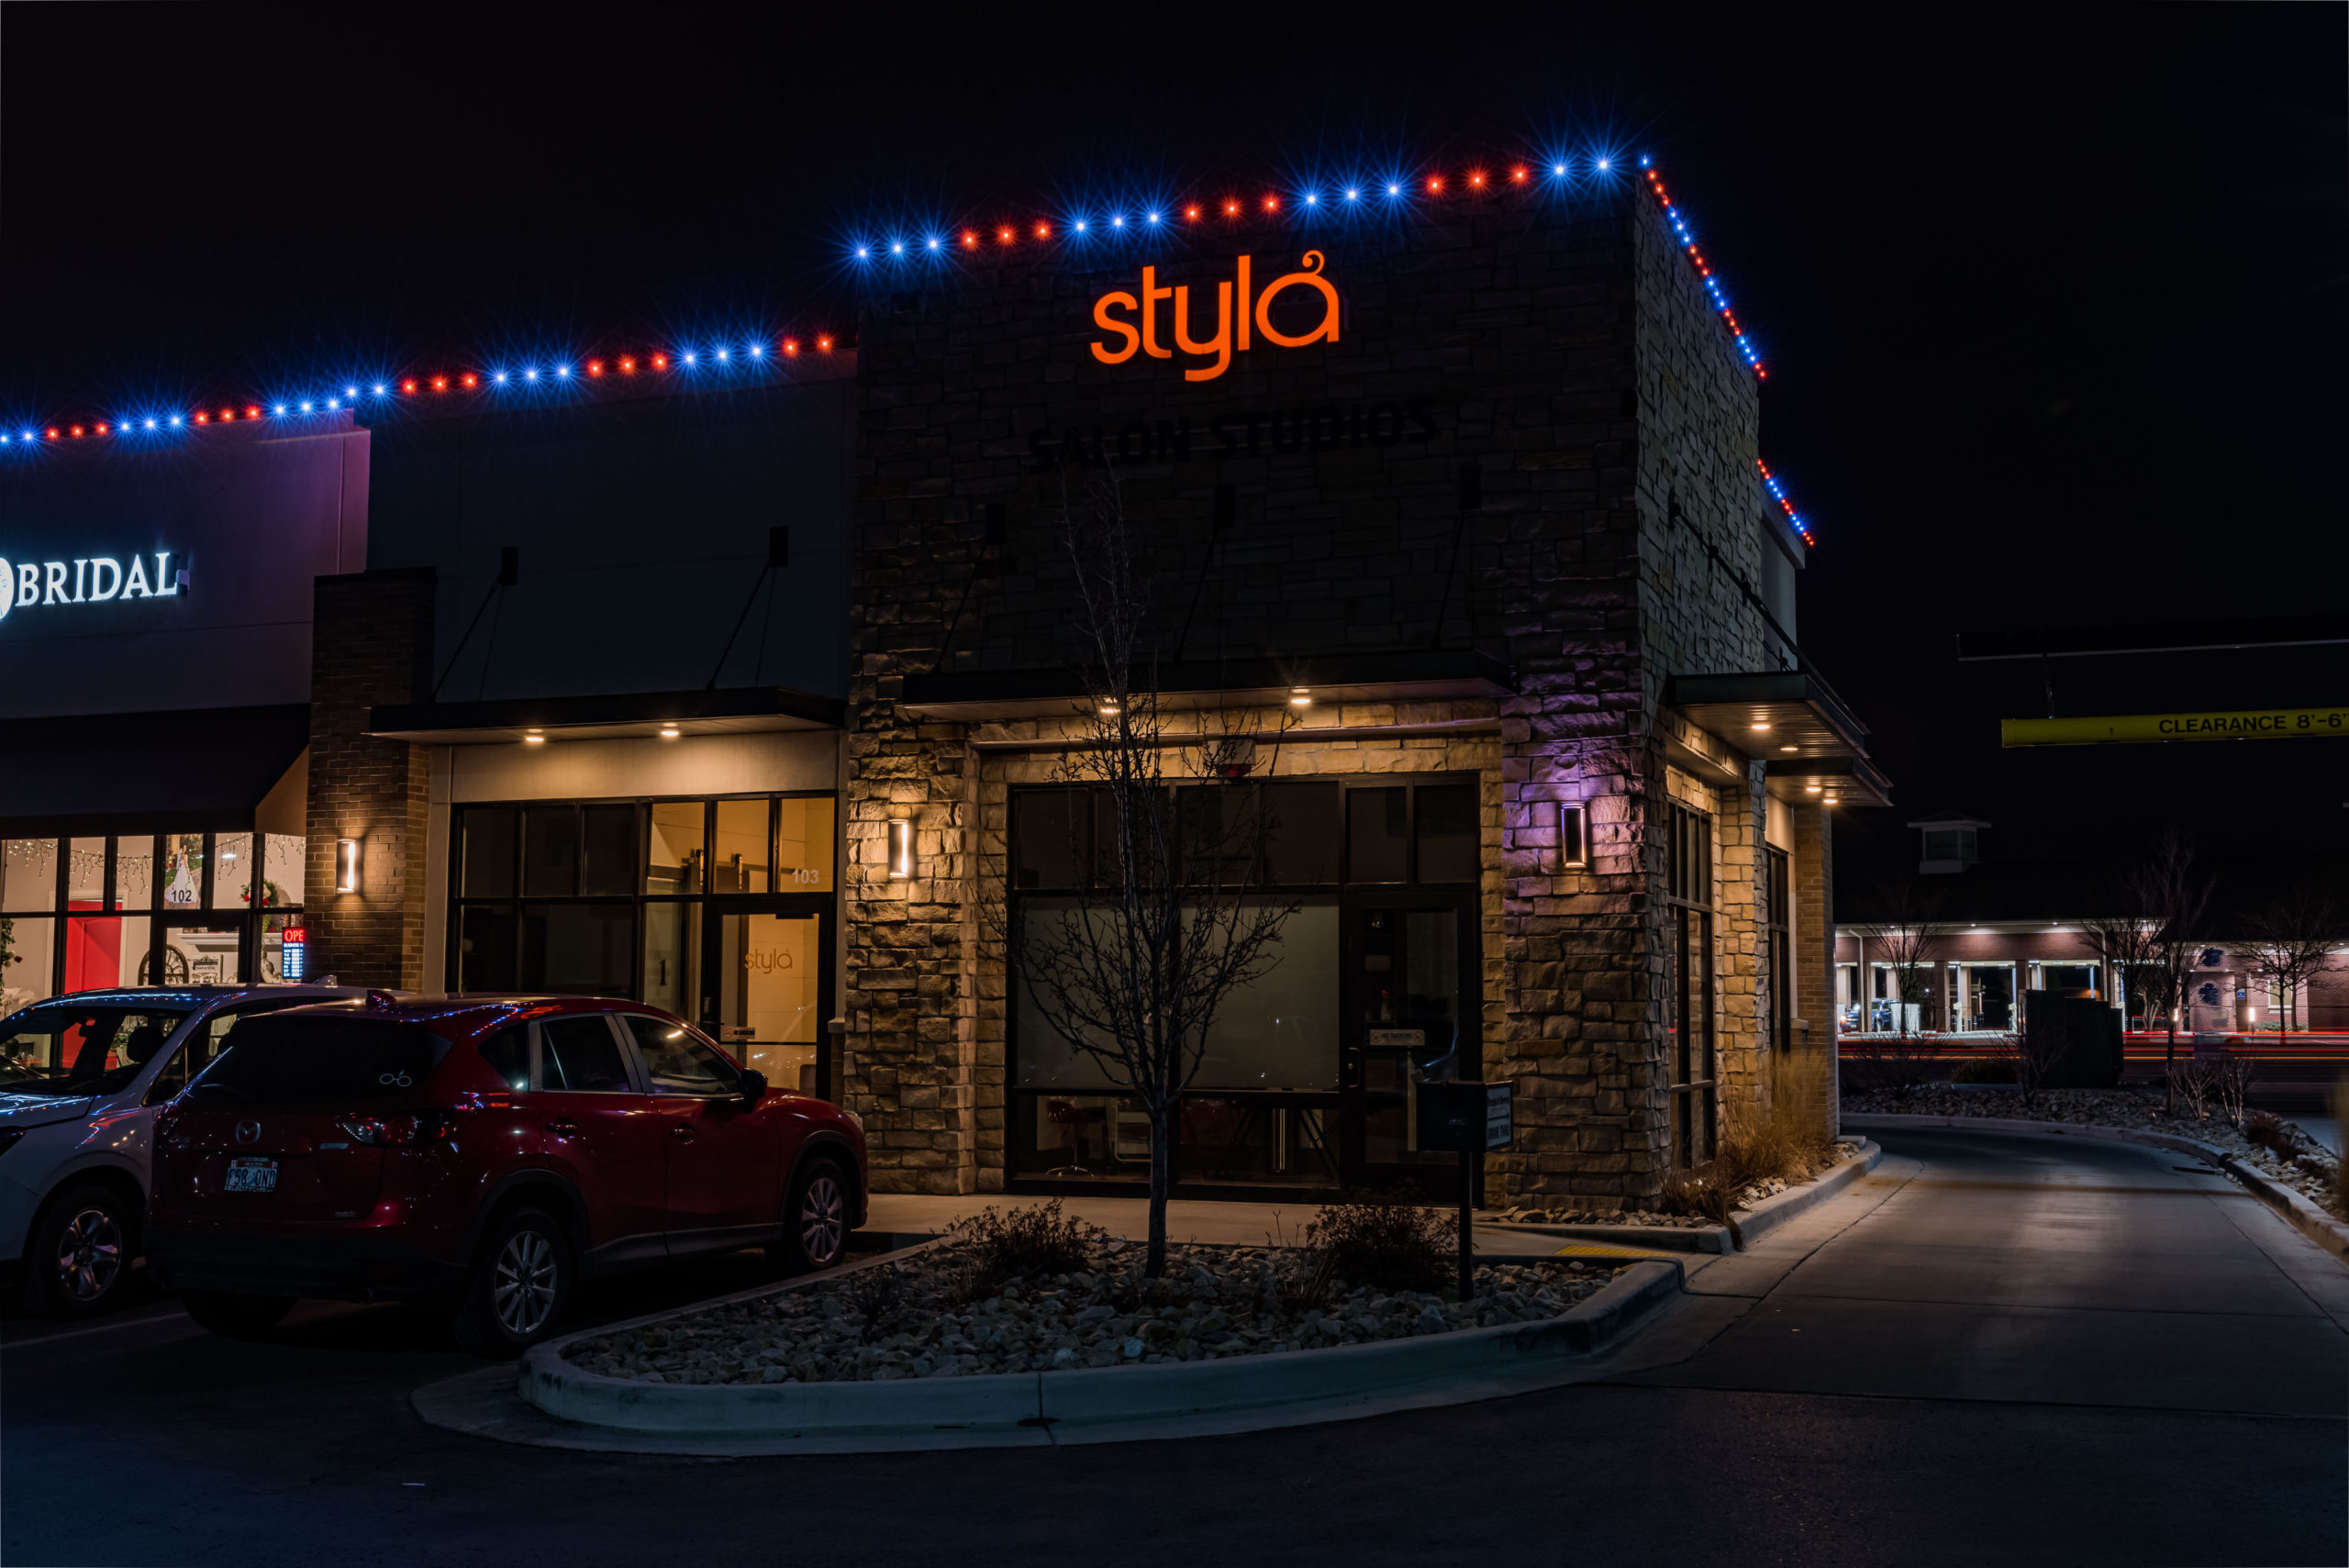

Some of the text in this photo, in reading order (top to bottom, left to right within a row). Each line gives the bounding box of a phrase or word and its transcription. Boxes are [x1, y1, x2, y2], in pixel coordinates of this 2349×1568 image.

[1029, 395, 1436, 472] SALON STUDIOS
[15, 552, 178, 606] BRIDAL
[2159, 716, 2288, 734] CLEARANCE
[792, 870, 819, 884] 103
[172, 890, 192, 902] 102
[284, 929, 304, 941] OPE
